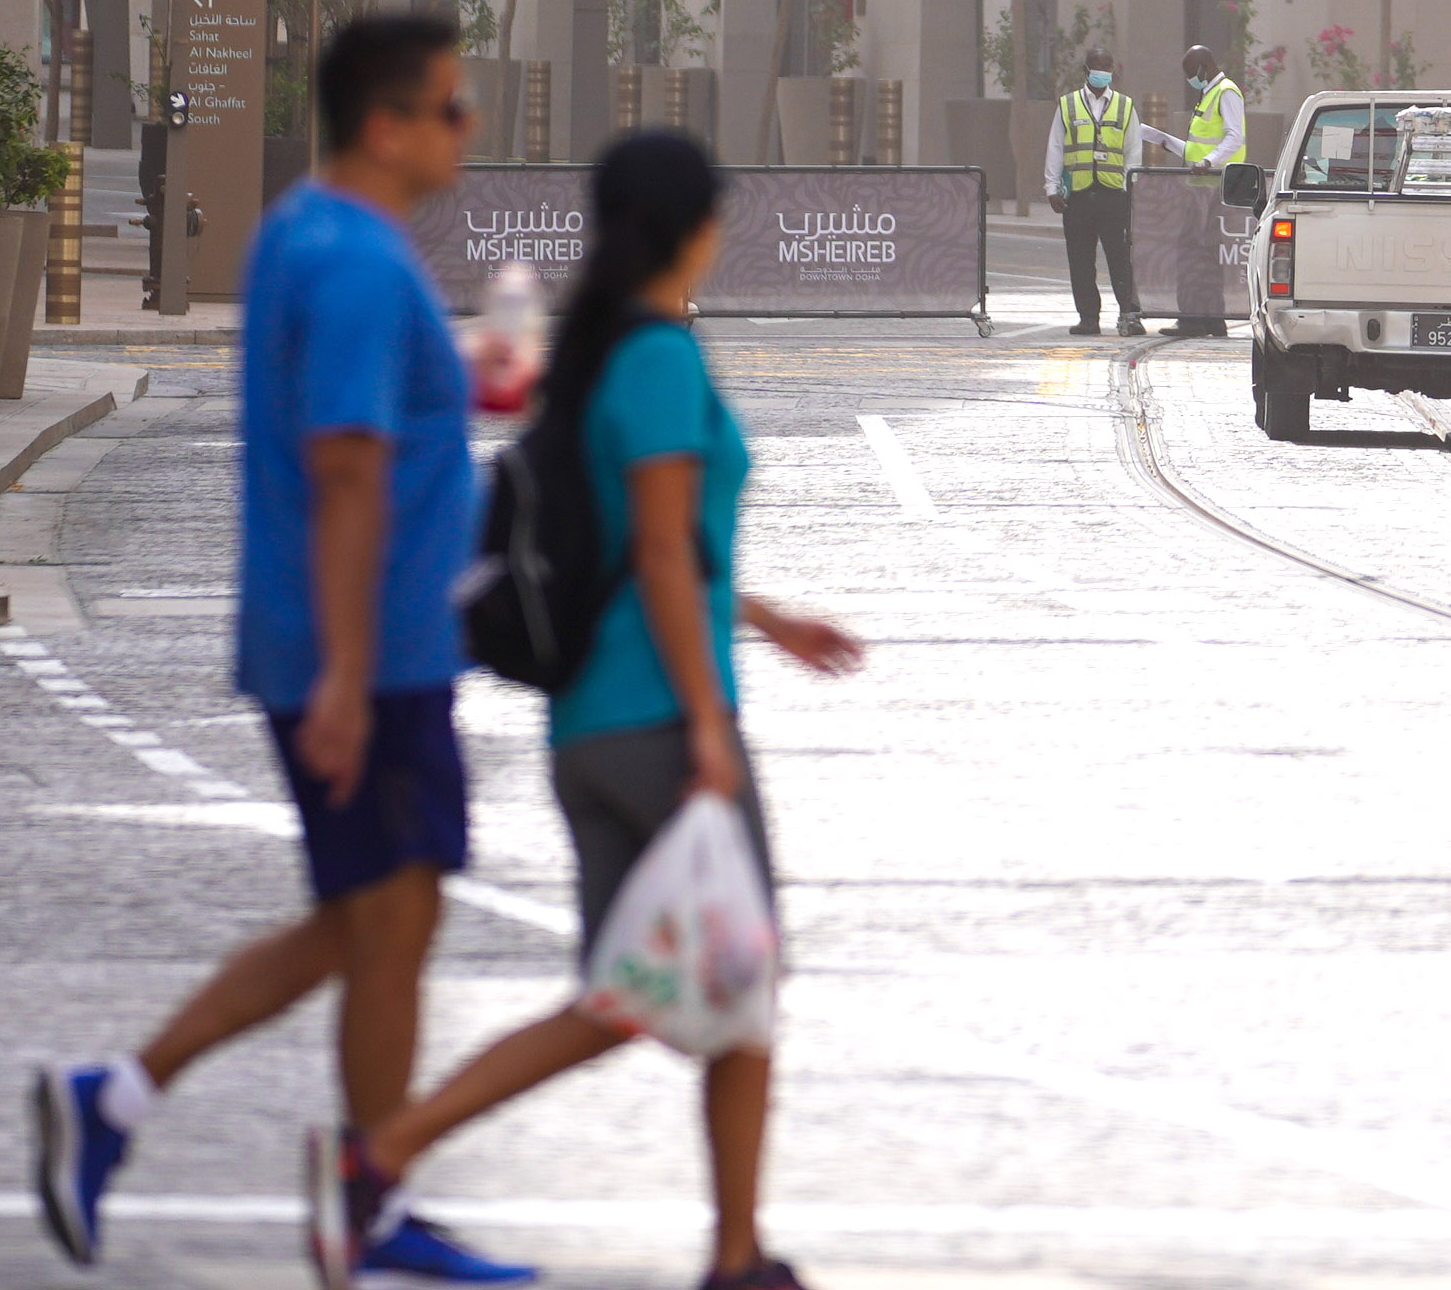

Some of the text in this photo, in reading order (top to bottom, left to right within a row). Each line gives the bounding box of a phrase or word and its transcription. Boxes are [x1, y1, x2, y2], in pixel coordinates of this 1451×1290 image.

[189, 13, 257, 27] ساحة النخيل
[189, 30, 220, 42] Sahat
[189, 46, 252, 59] Al Nakheel
[188, 96, 246, 109] Al Ghaffat
[187, 112, 221, 125] South
[464, 201, 584, 239] مشيرب
[776, 203, 897, 241] مشيرب
[466, 239, 585, 261] MSHEIREB
[778, 241, 897, 263] MSHEIREB
[544, 271, 569, 280] DOHA
[799, 273, 882, 282] DOWNTOWN DOHA
